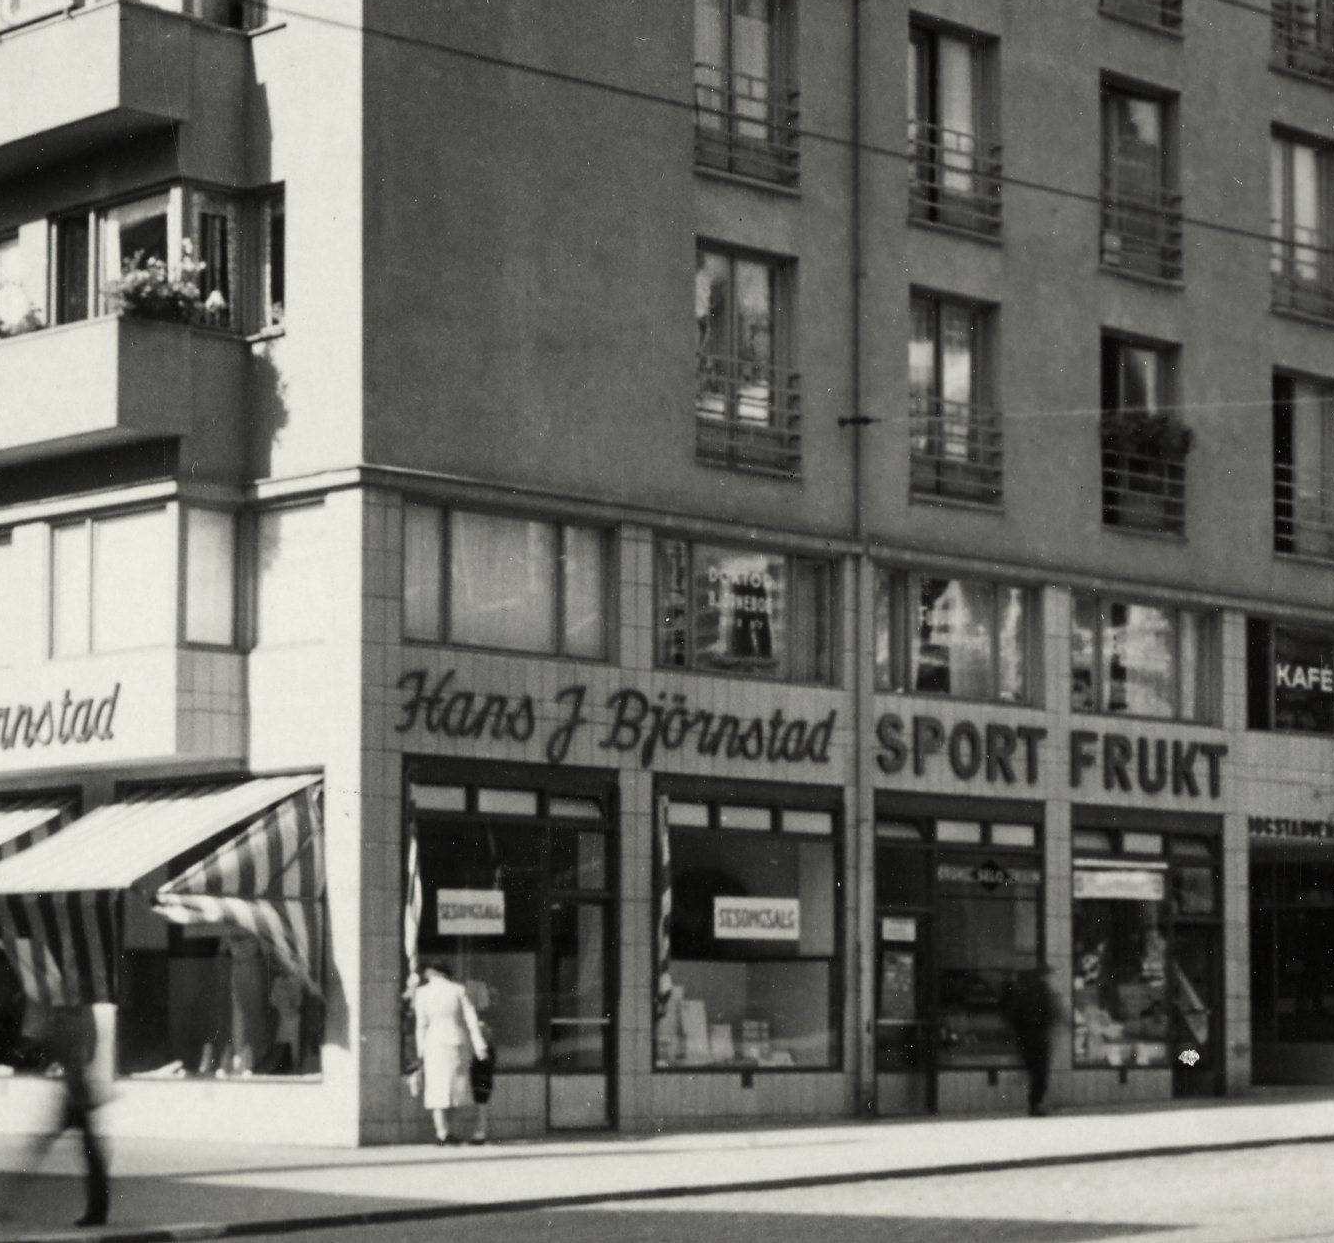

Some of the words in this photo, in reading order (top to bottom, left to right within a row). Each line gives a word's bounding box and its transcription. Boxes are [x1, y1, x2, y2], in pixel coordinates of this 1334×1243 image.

[394, 667, 535, 742] Hans
[546, 684, 587, 764] J
[598, 687, 836, 768] Björnstad
[1275, 662, 1333, 692] KAFE
[875, 712, 1048, 786] SPORT
[1069, 729, 1229, 799] FRUKT
